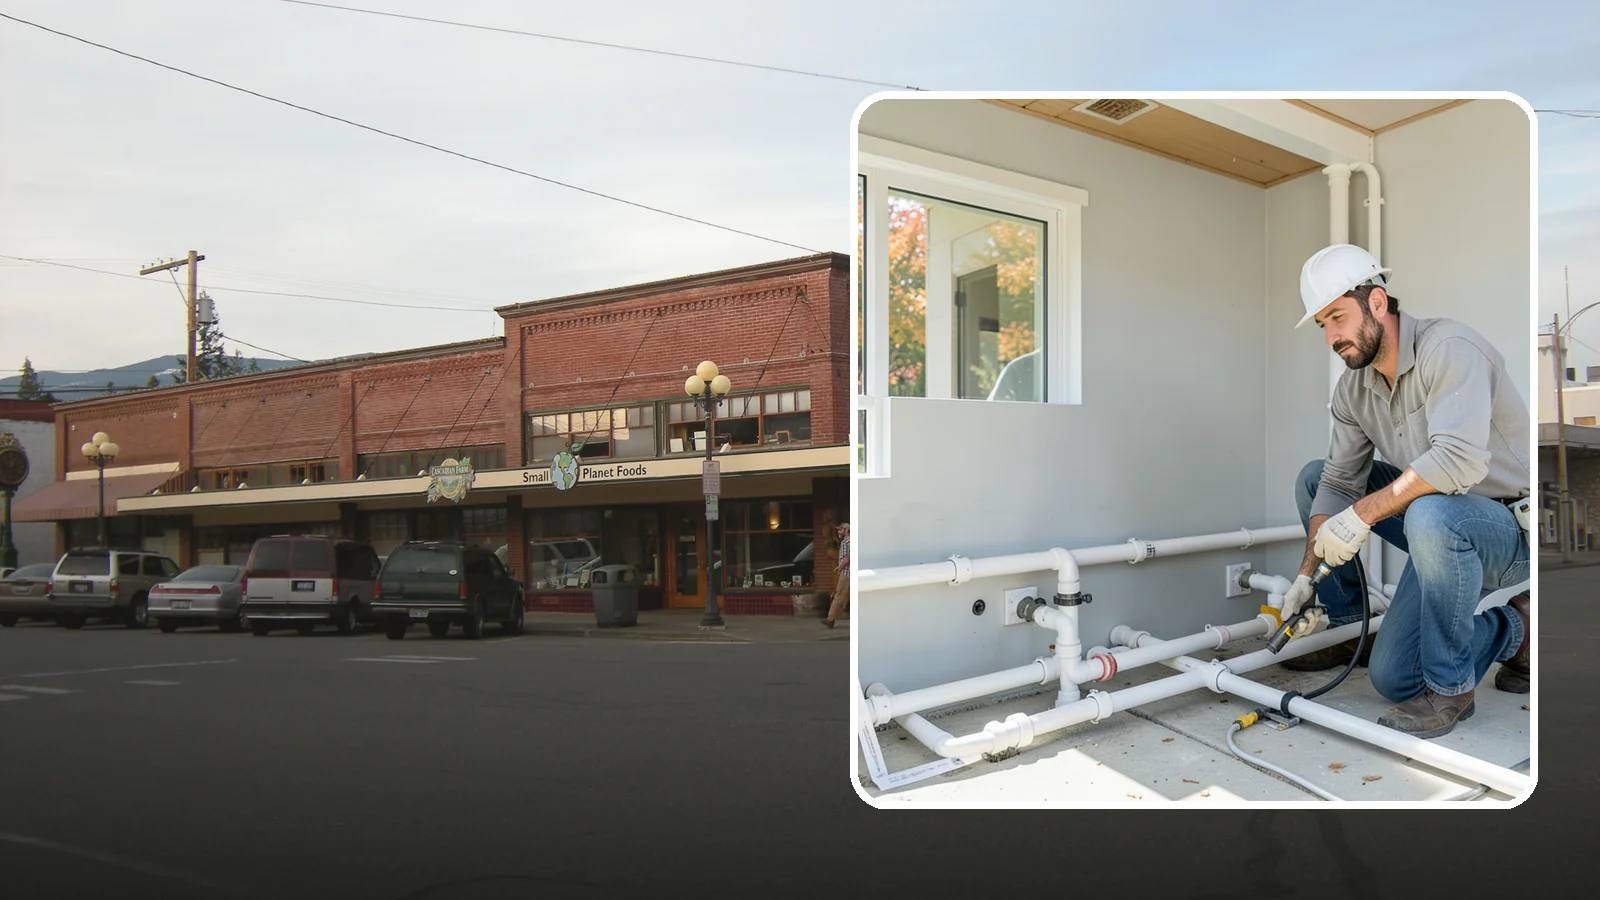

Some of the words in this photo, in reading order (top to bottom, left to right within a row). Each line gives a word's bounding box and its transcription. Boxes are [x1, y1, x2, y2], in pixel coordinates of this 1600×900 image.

[523, 471, 549, 482] Small
[583, 467, 614, 479] Planet
[617, 464, 647, 476] Foods
